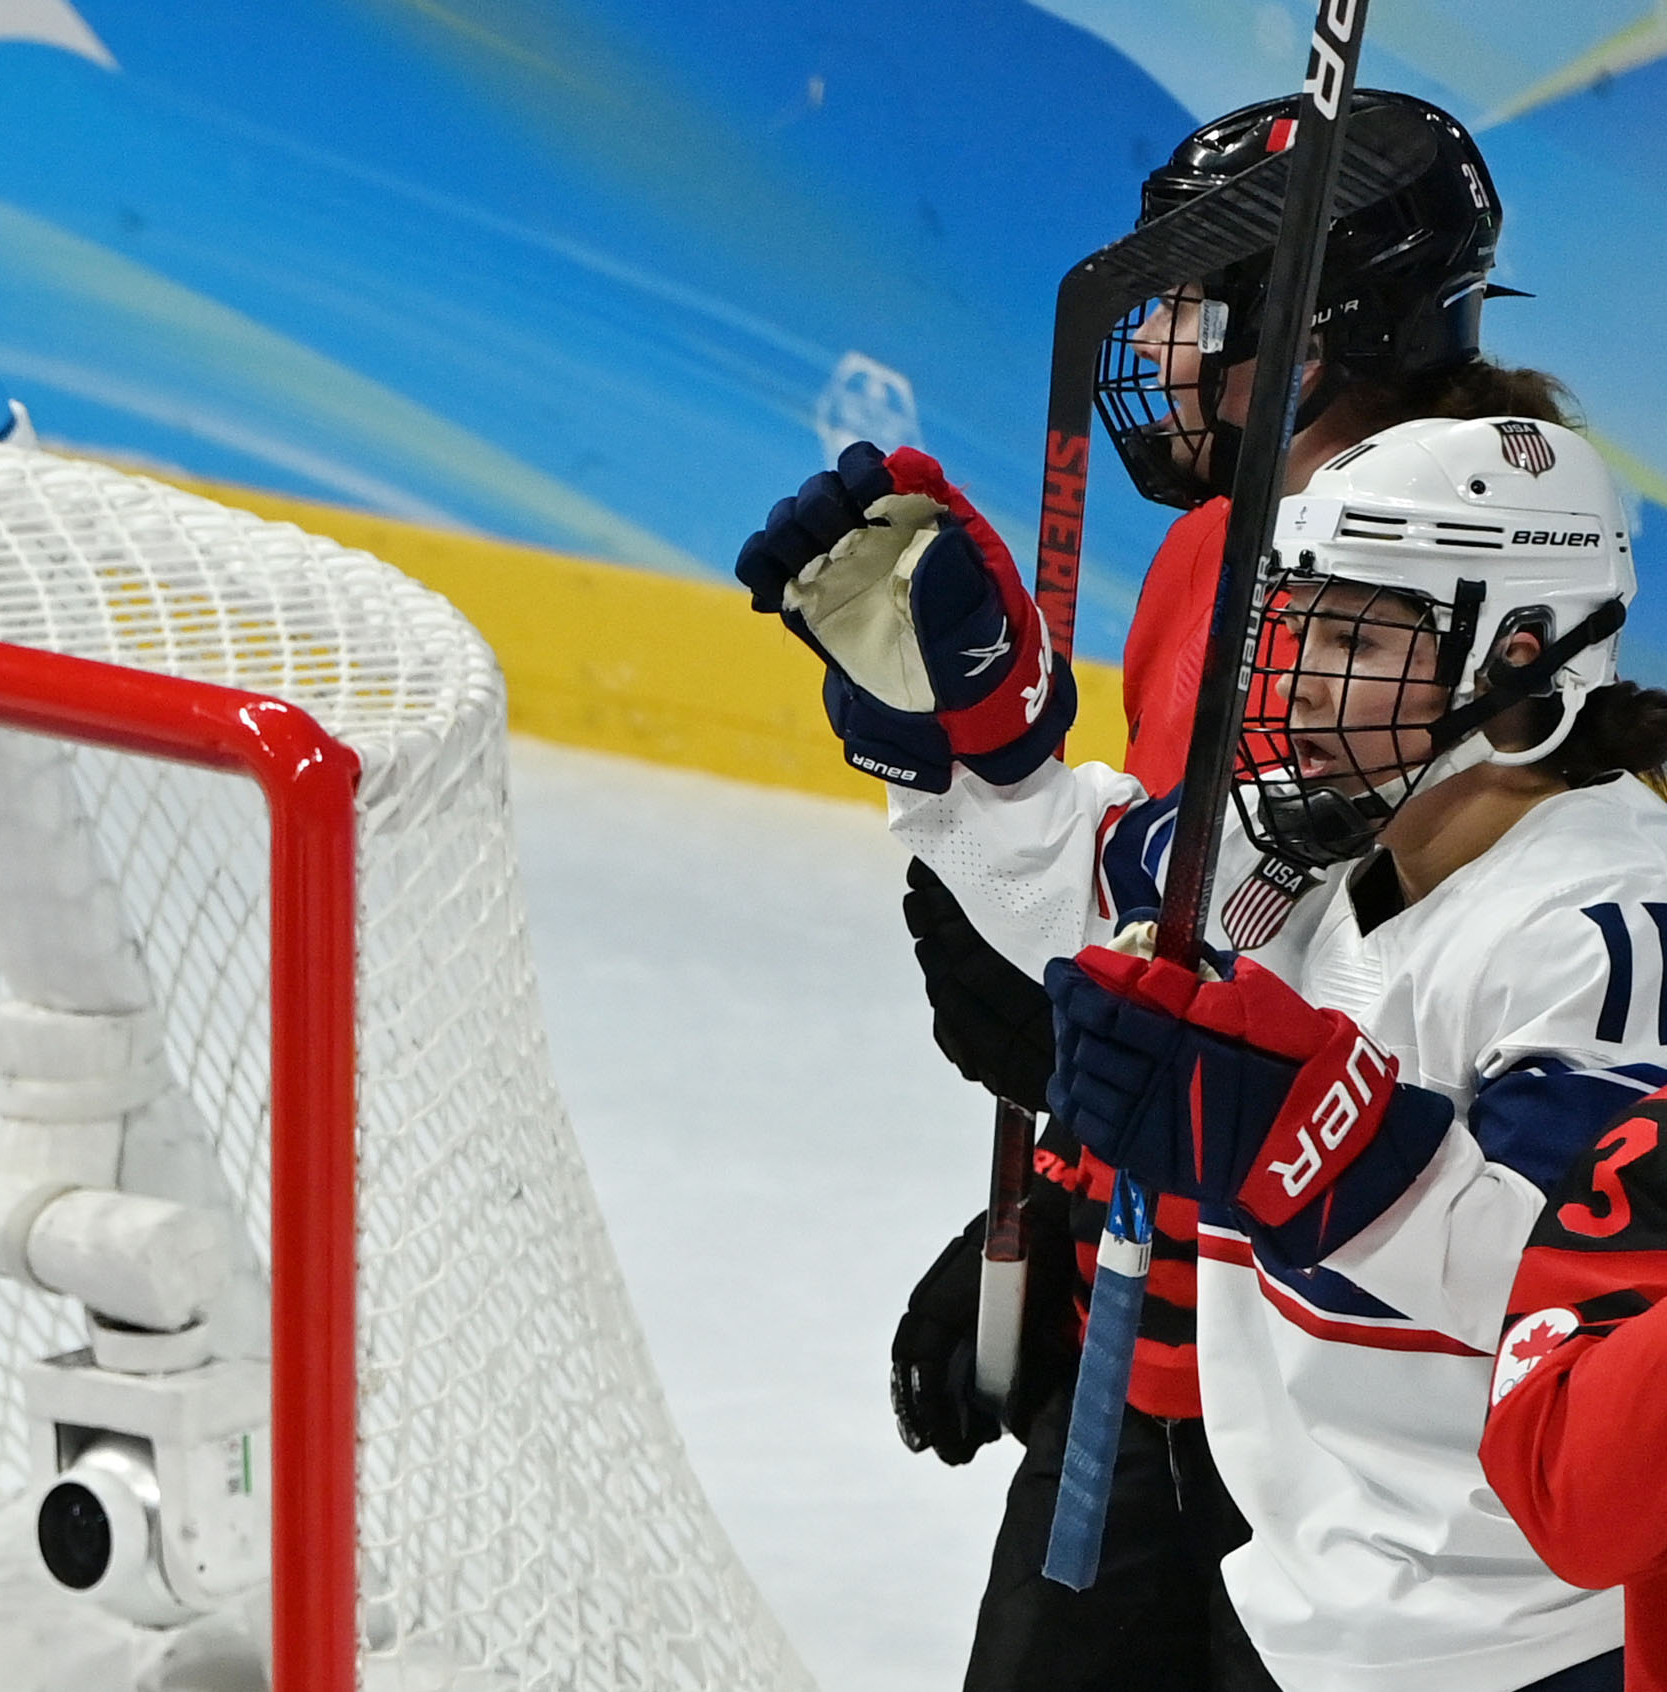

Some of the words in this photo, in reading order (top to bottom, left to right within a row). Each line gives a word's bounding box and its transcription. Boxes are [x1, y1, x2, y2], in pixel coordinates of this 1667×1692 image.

[1501, 422, 1534, 434] USA
[1510, 529, 1601, 549] BAUER
[1237, 555, 1271, 692] BAUER
[852, 752, 918, 782] BAUER
[1262, 856, 1305, 893] USA
[1556, 1116, 1659, 1240] 3
